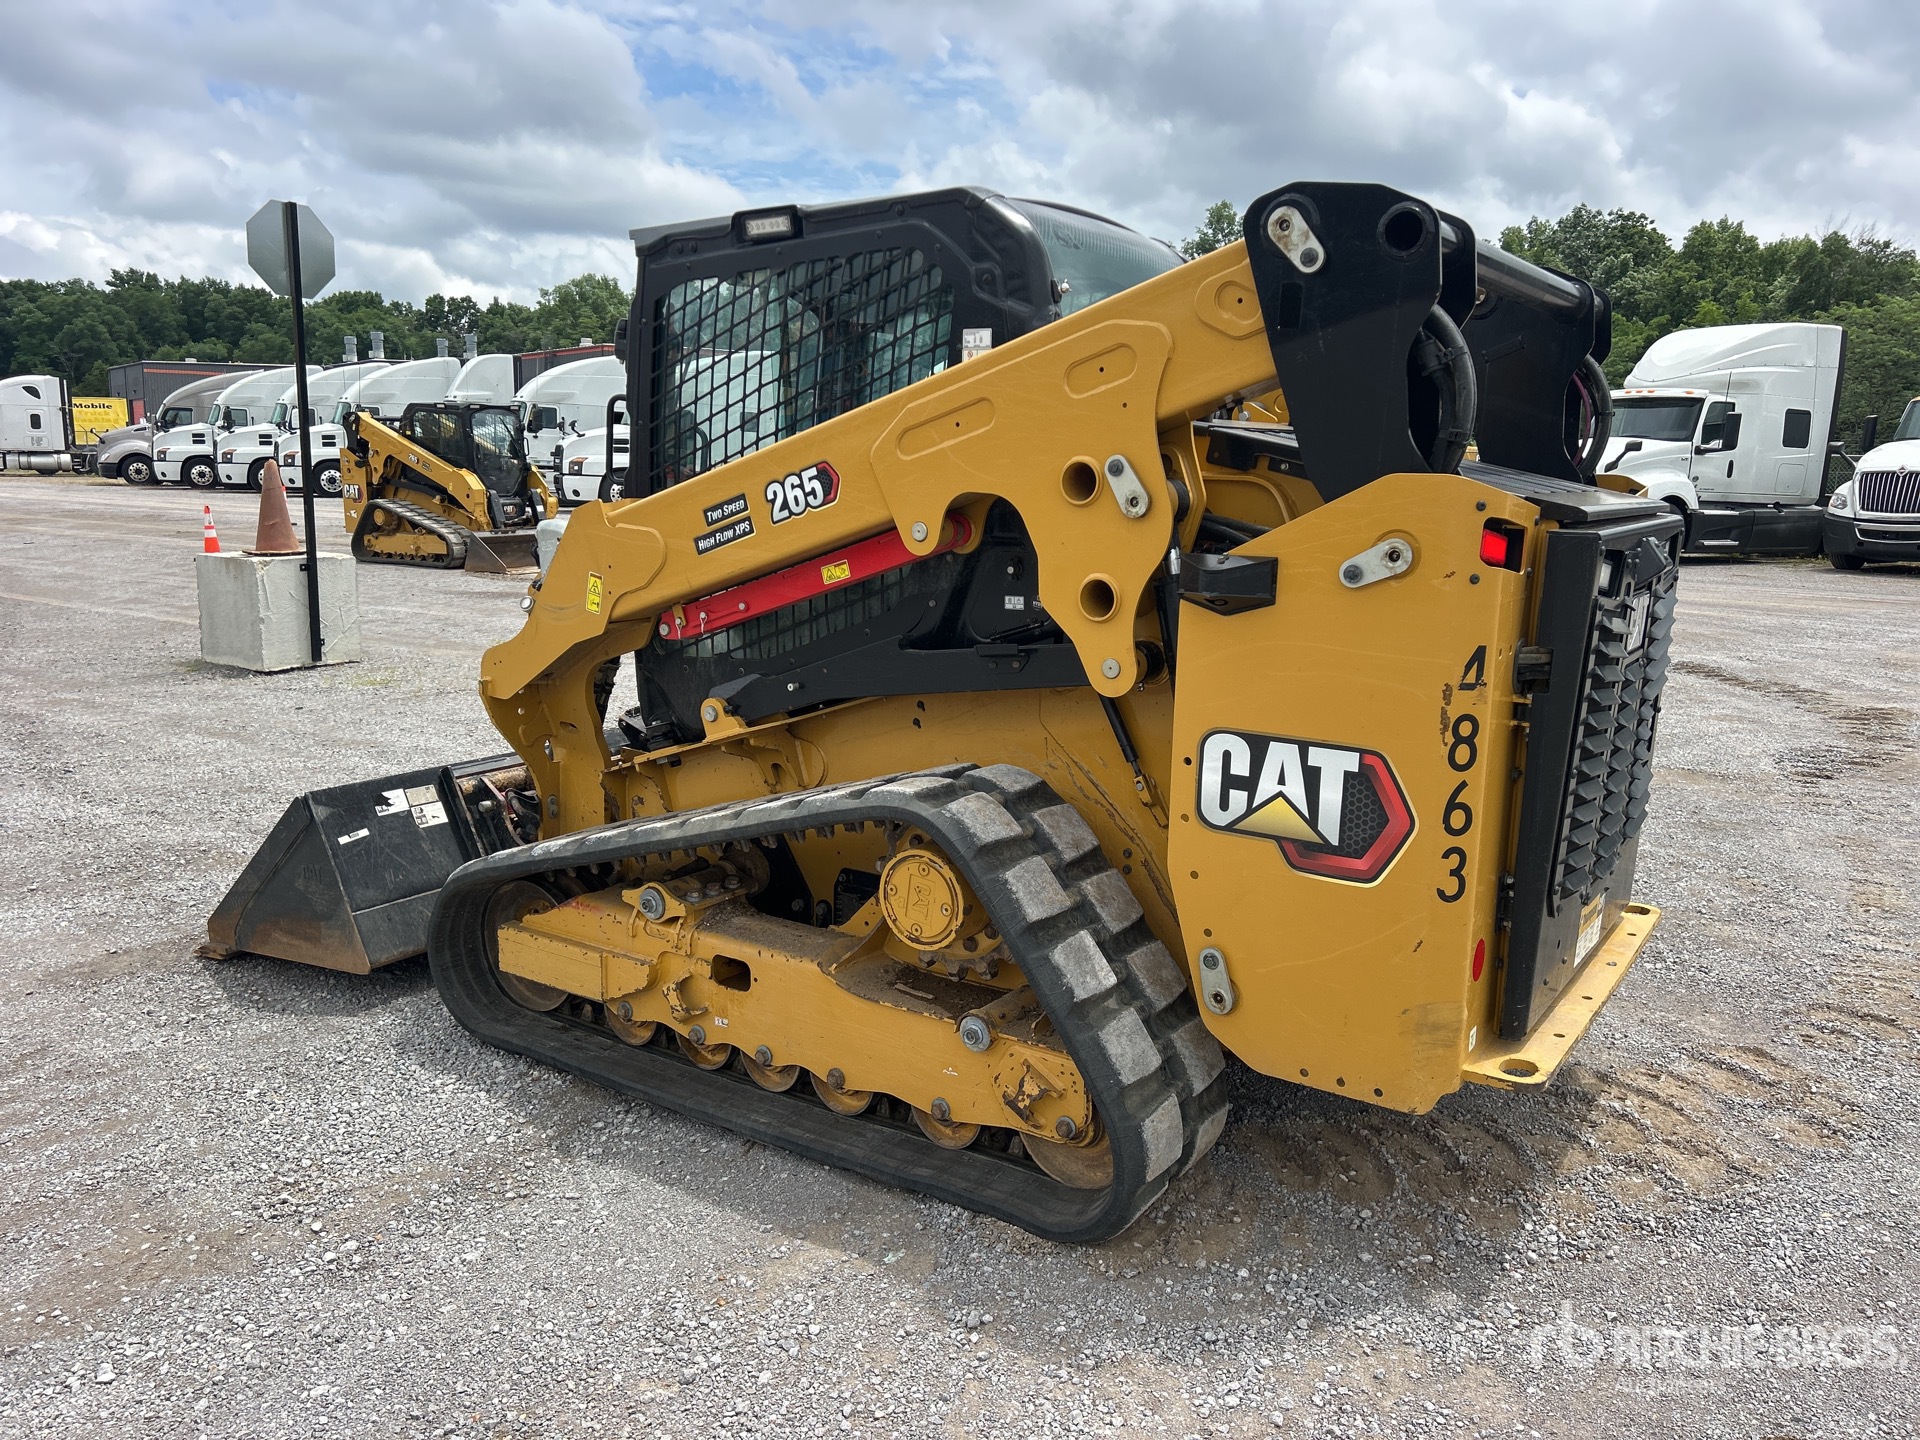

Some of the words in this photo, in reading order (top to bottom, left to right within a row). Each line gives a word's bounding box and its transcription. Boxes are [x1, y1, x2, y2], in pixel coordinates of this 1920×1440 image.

[344, 484, 359, 499] CAT
[766, 467, 824, 522] 265
[734, 520, 751, 536] XPS
[1200, 732, 1360, 846] CAT
